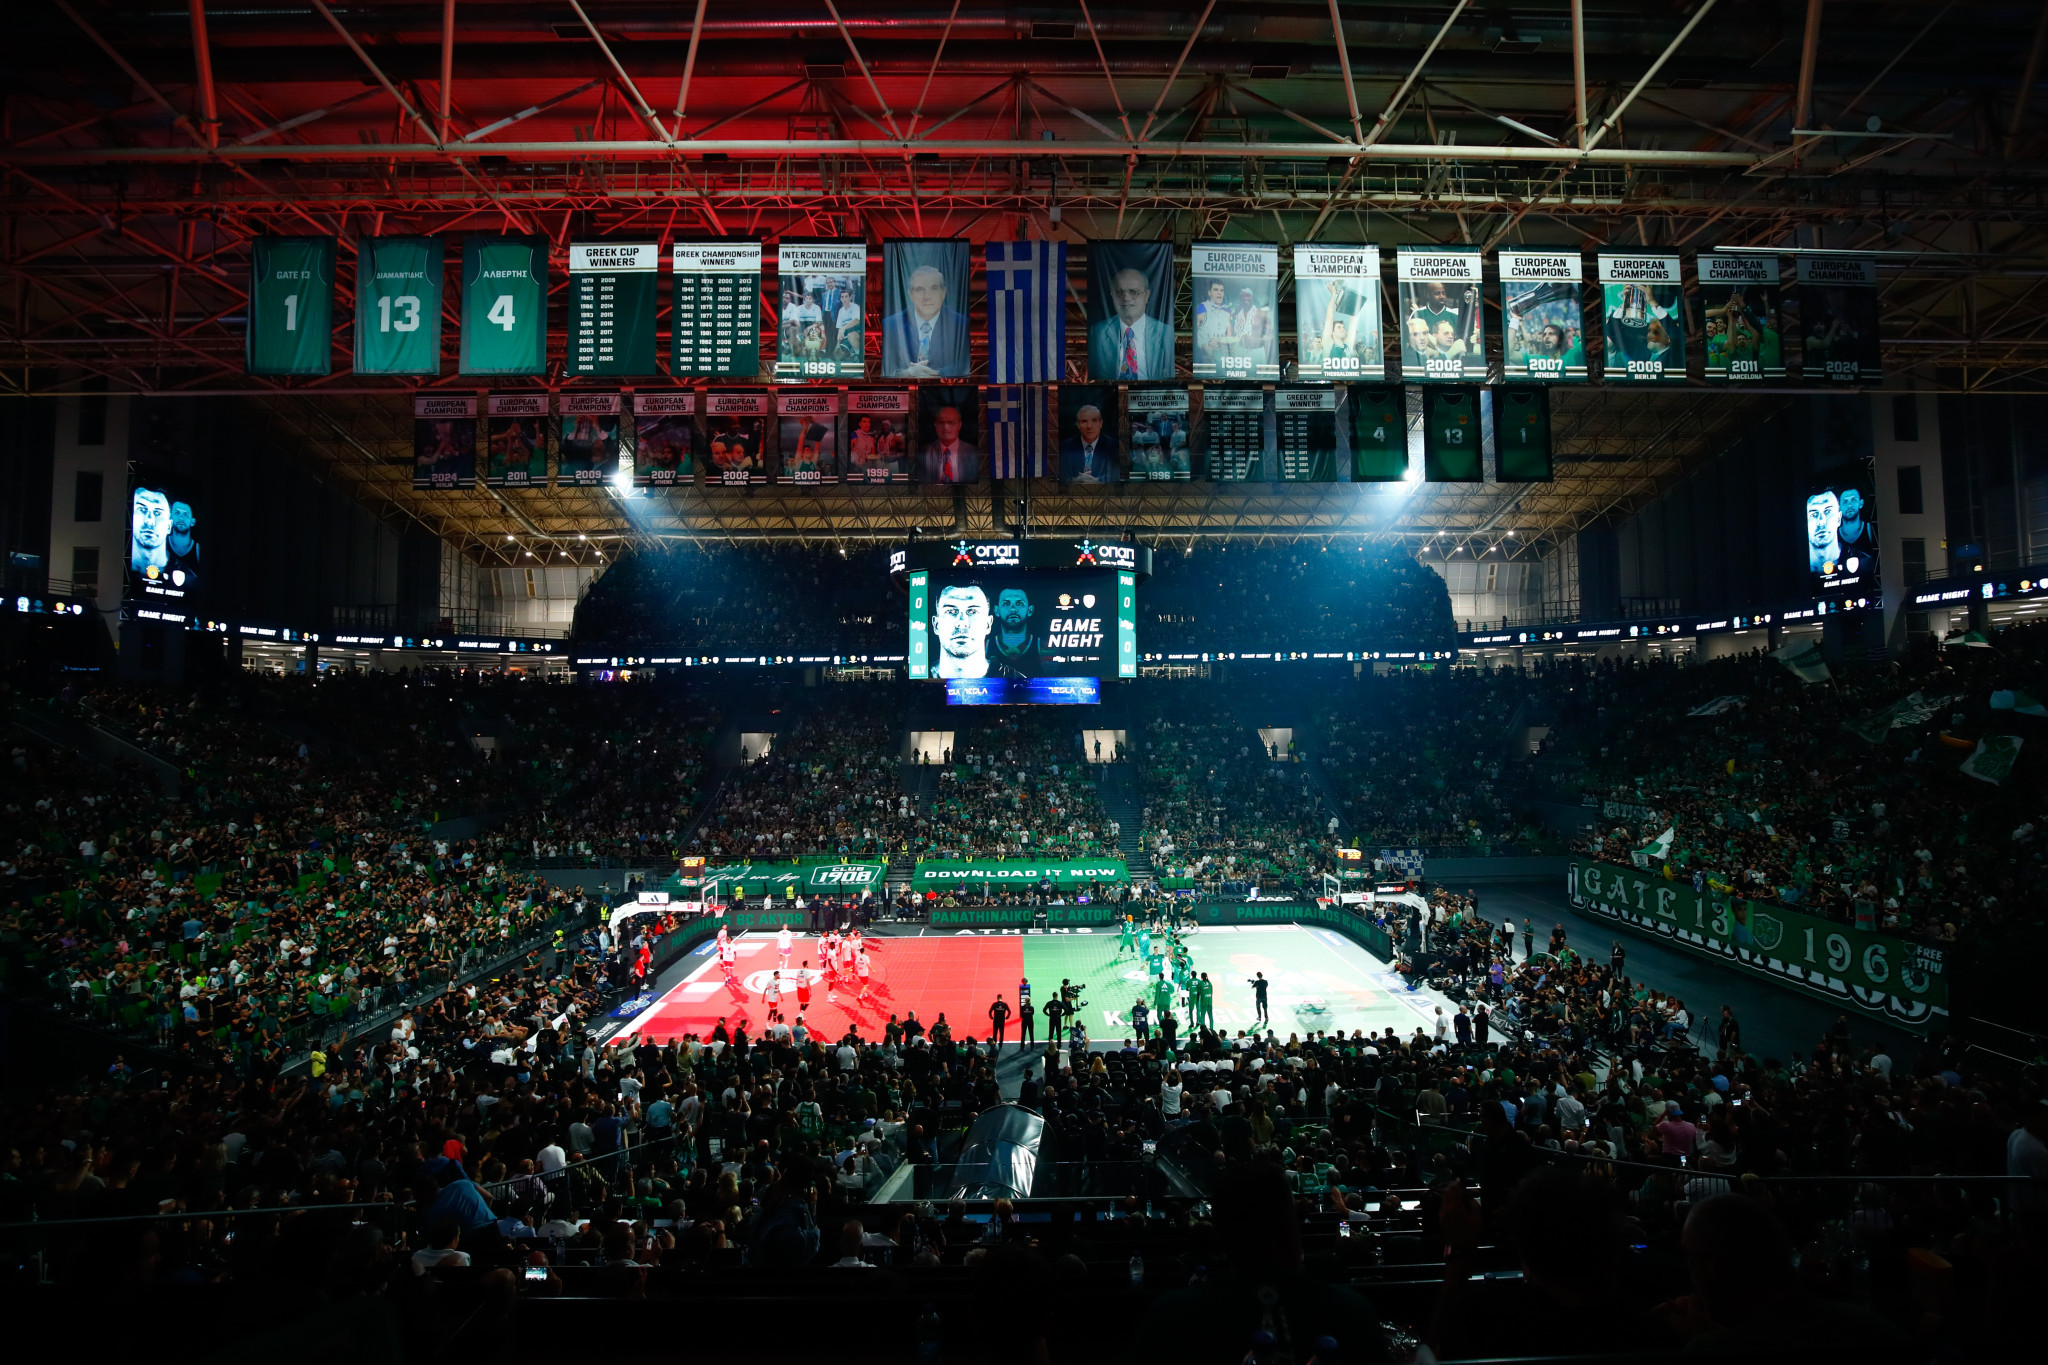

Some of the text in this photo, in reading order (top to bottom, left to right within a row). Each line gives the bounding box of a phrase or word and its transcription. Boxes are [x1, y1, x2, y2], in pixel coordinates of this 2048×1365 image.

[586, 248, 639, 257] GREEK CUP
[782, 251, 863, 260] INTERCONTINENTAL
[590, 258, 635, 267] WINNERS
[1207, 253, 1262, 263] EUROPEAN
[1310, 255, 1363, 264] EUROPEAN
[1413, 258, 1466, 267] EUROPEAN
[1515, 258, 1567, 268] EUROPEAN
[793, 260, 851, 269] CUP WINNERS
[1203, 263, 1265, 273] CHAMPIONS
[1306, 264, 1367, 274] CHAMPIONS
[1613, 260, 1665, 270] EUROPEAN
[1712, 260, 1763, 270] EUROPEAN
[1811, 261, 1861, 271] EUROPEAN
[277, 271, 311, 280] GATE 13
[376, 271, 424, 279] ΔΙΑΜΑΝΤΙΔΗΣ
[483, 270, 527, 278] ΑΛΒΕΡΤΗΣ
[1409, 267, 1470, 277] CHAMPIONS
[1511, 267, 1571, 277] CHAMPIONS
[1610, 270, 1669, 279] CHAMPIONS
[1709, 270, 1767, 280] CHAMPIONS
[1808, 270, 1865, 281] CHAMPIONS
[284, 294, 298, 331] 1
[378, 296, 421, 332] 13
[487, 295, 516, 331] 4
[1220, 357, 1251, 369] 1996
[1322, 357, 1359, 370] 2000
[1426, 359, 1462, 372] 2002
[1529, 359, 1563, 371] 2007
[1627, 361, 1663, 373] 2009
[1731, 360, 1758, 372] 2011
[1826, 361, 1859, 373] 2024
[804, 362, 836, 375] 1996
[645, 397, 684, 405] EUROPEAN
[718, 397, 757, 405] EUROPEAN
[1373, 427, 1385, 443] 4
[1444, 428, 1463, 444] 13
[1520, 428, 1527, 443] 1
[507, 472, 527, 481] 2011
[575, 470, 602, 479] 2009
[651, 471, 676, 479] 2007
[723, 471, 749, 480] 2002
[794, 471, 821, 480] 2000
[867, 468, 889, 477] 1996
[1148, 472, 1170, 480] 1996
[431, 473, 457, 483] 2024
[1916, 589, 1970, 604] GAME NIGHT
[915, 597, 922, 609] 0
[1124, 597, 1131, 608] 0
[1050, 618, 1101, 632] GAME
[1048, 634, 1104, 647] NIGHT
[915, 642, 923, 653] 0
[1124, 641, 1131, 653] 0
[818, 871, 872, 883] 1908
[924, 870, 1038, 879] DOWNLOAD
[1070, 869, 1116, 877] NOW
[1583, 867, 1677, 921] GATE
[1694, 896, 1729, 936] 13
[736, 911, 755, 925] BC
[759, 913, 804, 925] AKTOR
[932, 909, 1112, 924] PANATHINAIKO BC AKTOR
[1236, 906, 1340, 923] PANATHINAIKOS
[1917, 945, 1943, 961] FREE
[801, 1116, 812, 1128] 41
